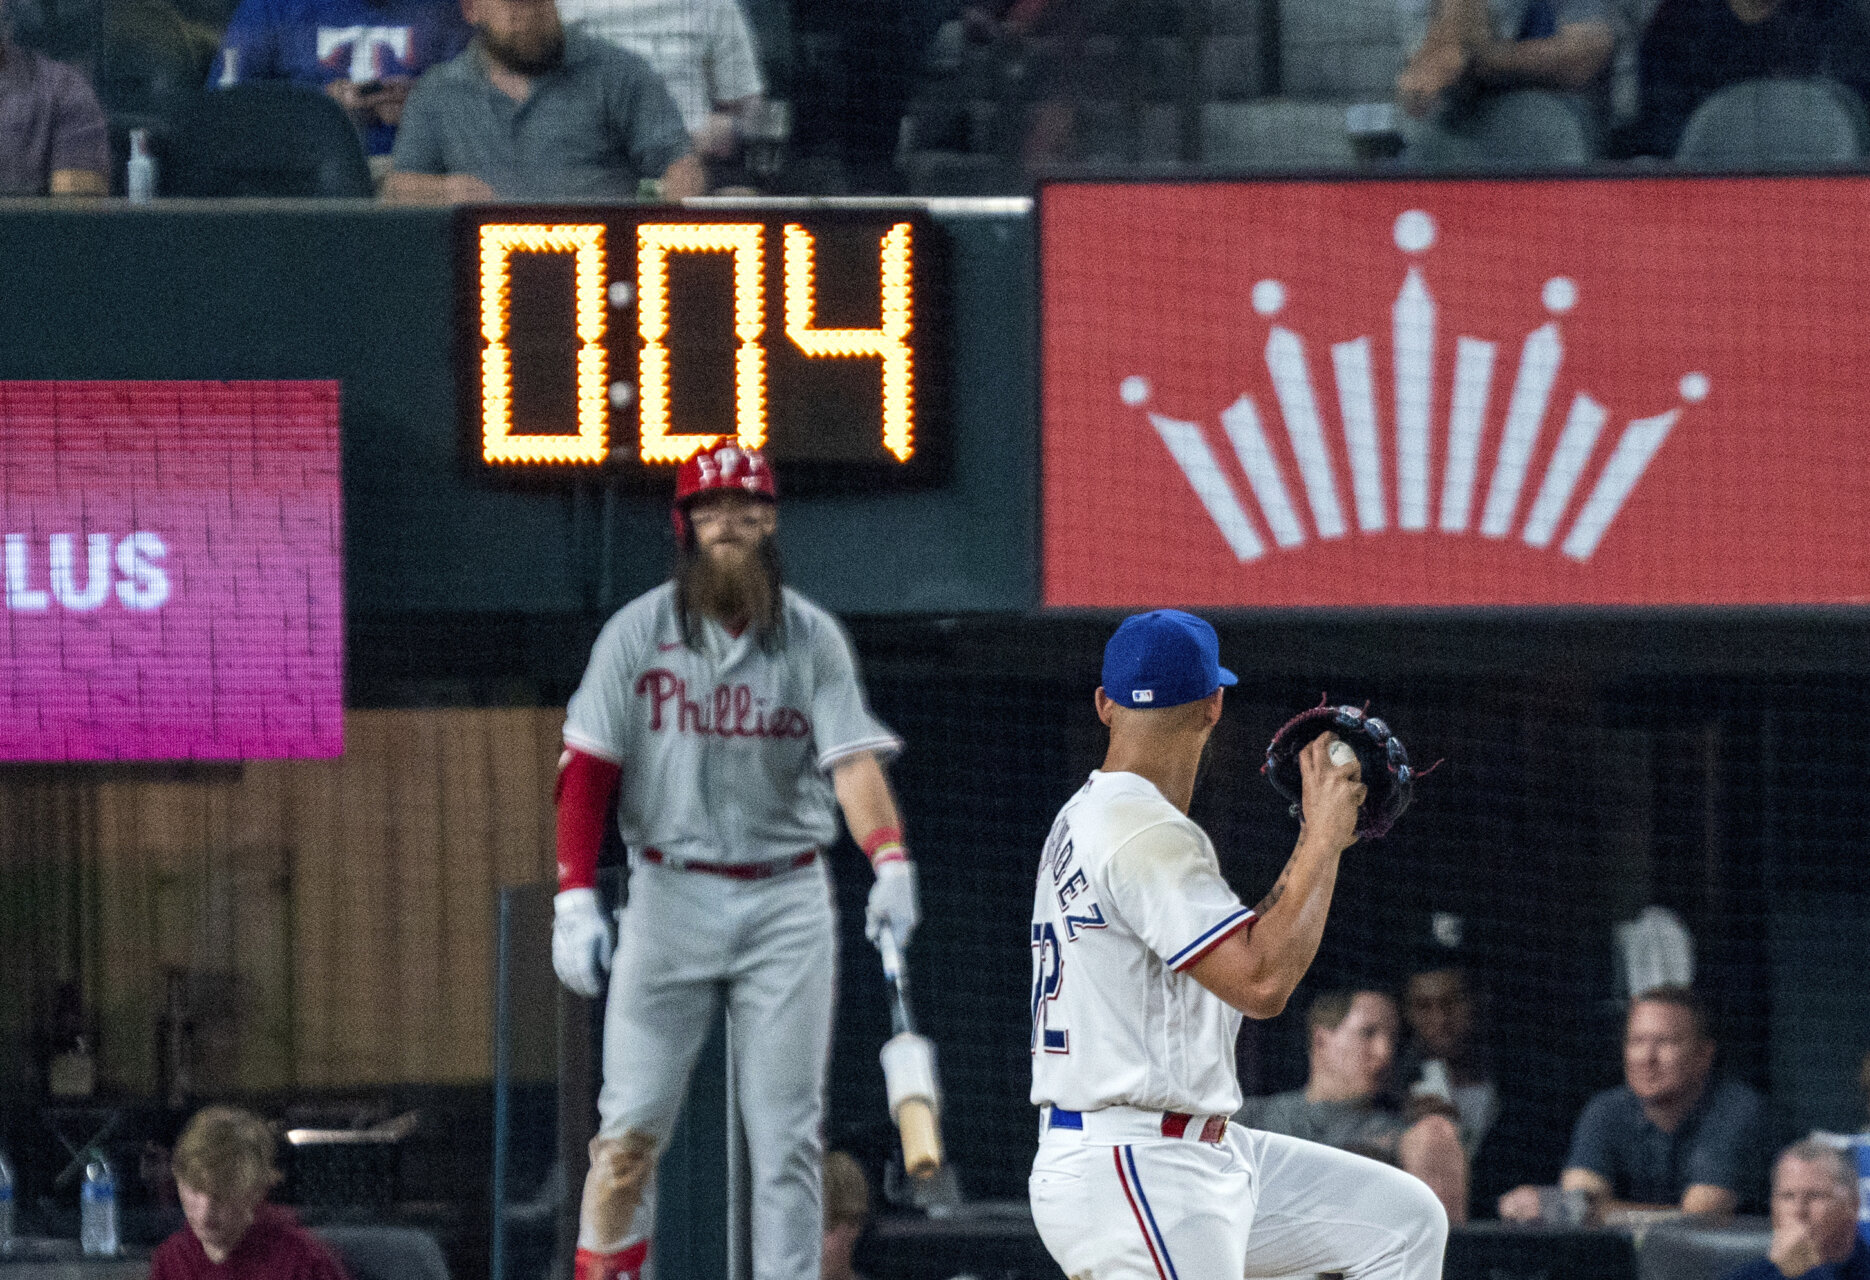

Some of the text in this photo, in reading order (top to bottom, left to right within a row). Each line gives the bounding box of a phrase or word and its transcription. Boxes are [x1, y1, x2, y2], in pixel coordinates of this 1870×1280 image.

[480, 223, 914, 464] 0:04
[5, 531, 169, 611] LUS
[635, 668, 811, 738] Phillies
